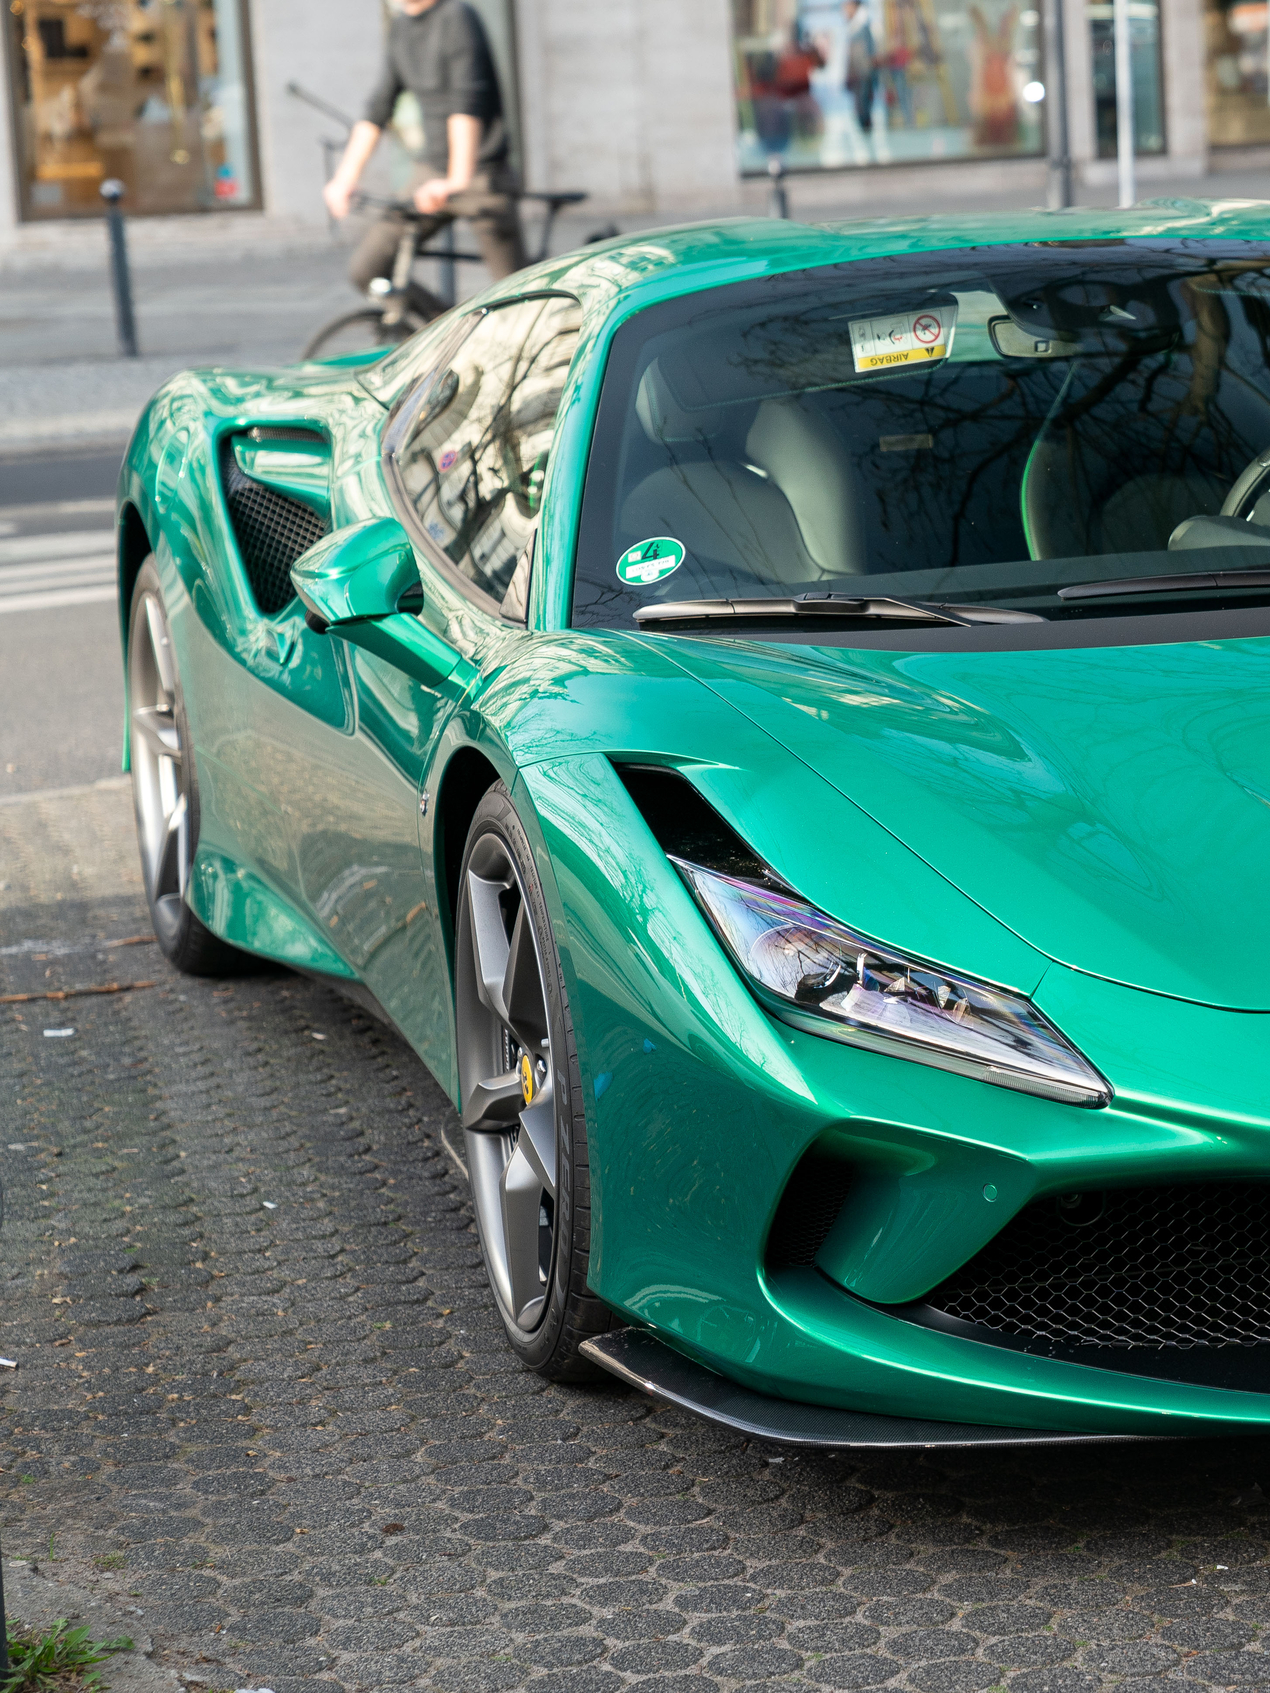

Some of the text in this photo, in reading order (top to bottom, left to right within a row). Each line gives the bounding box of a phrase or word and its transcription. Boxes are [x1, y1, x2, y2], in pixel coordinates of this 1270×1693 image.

[870, 353, 909, 366] AIRBAG
[641, 541, 660, 560] 4
[560, 1115, 570, 1259] ZERO
